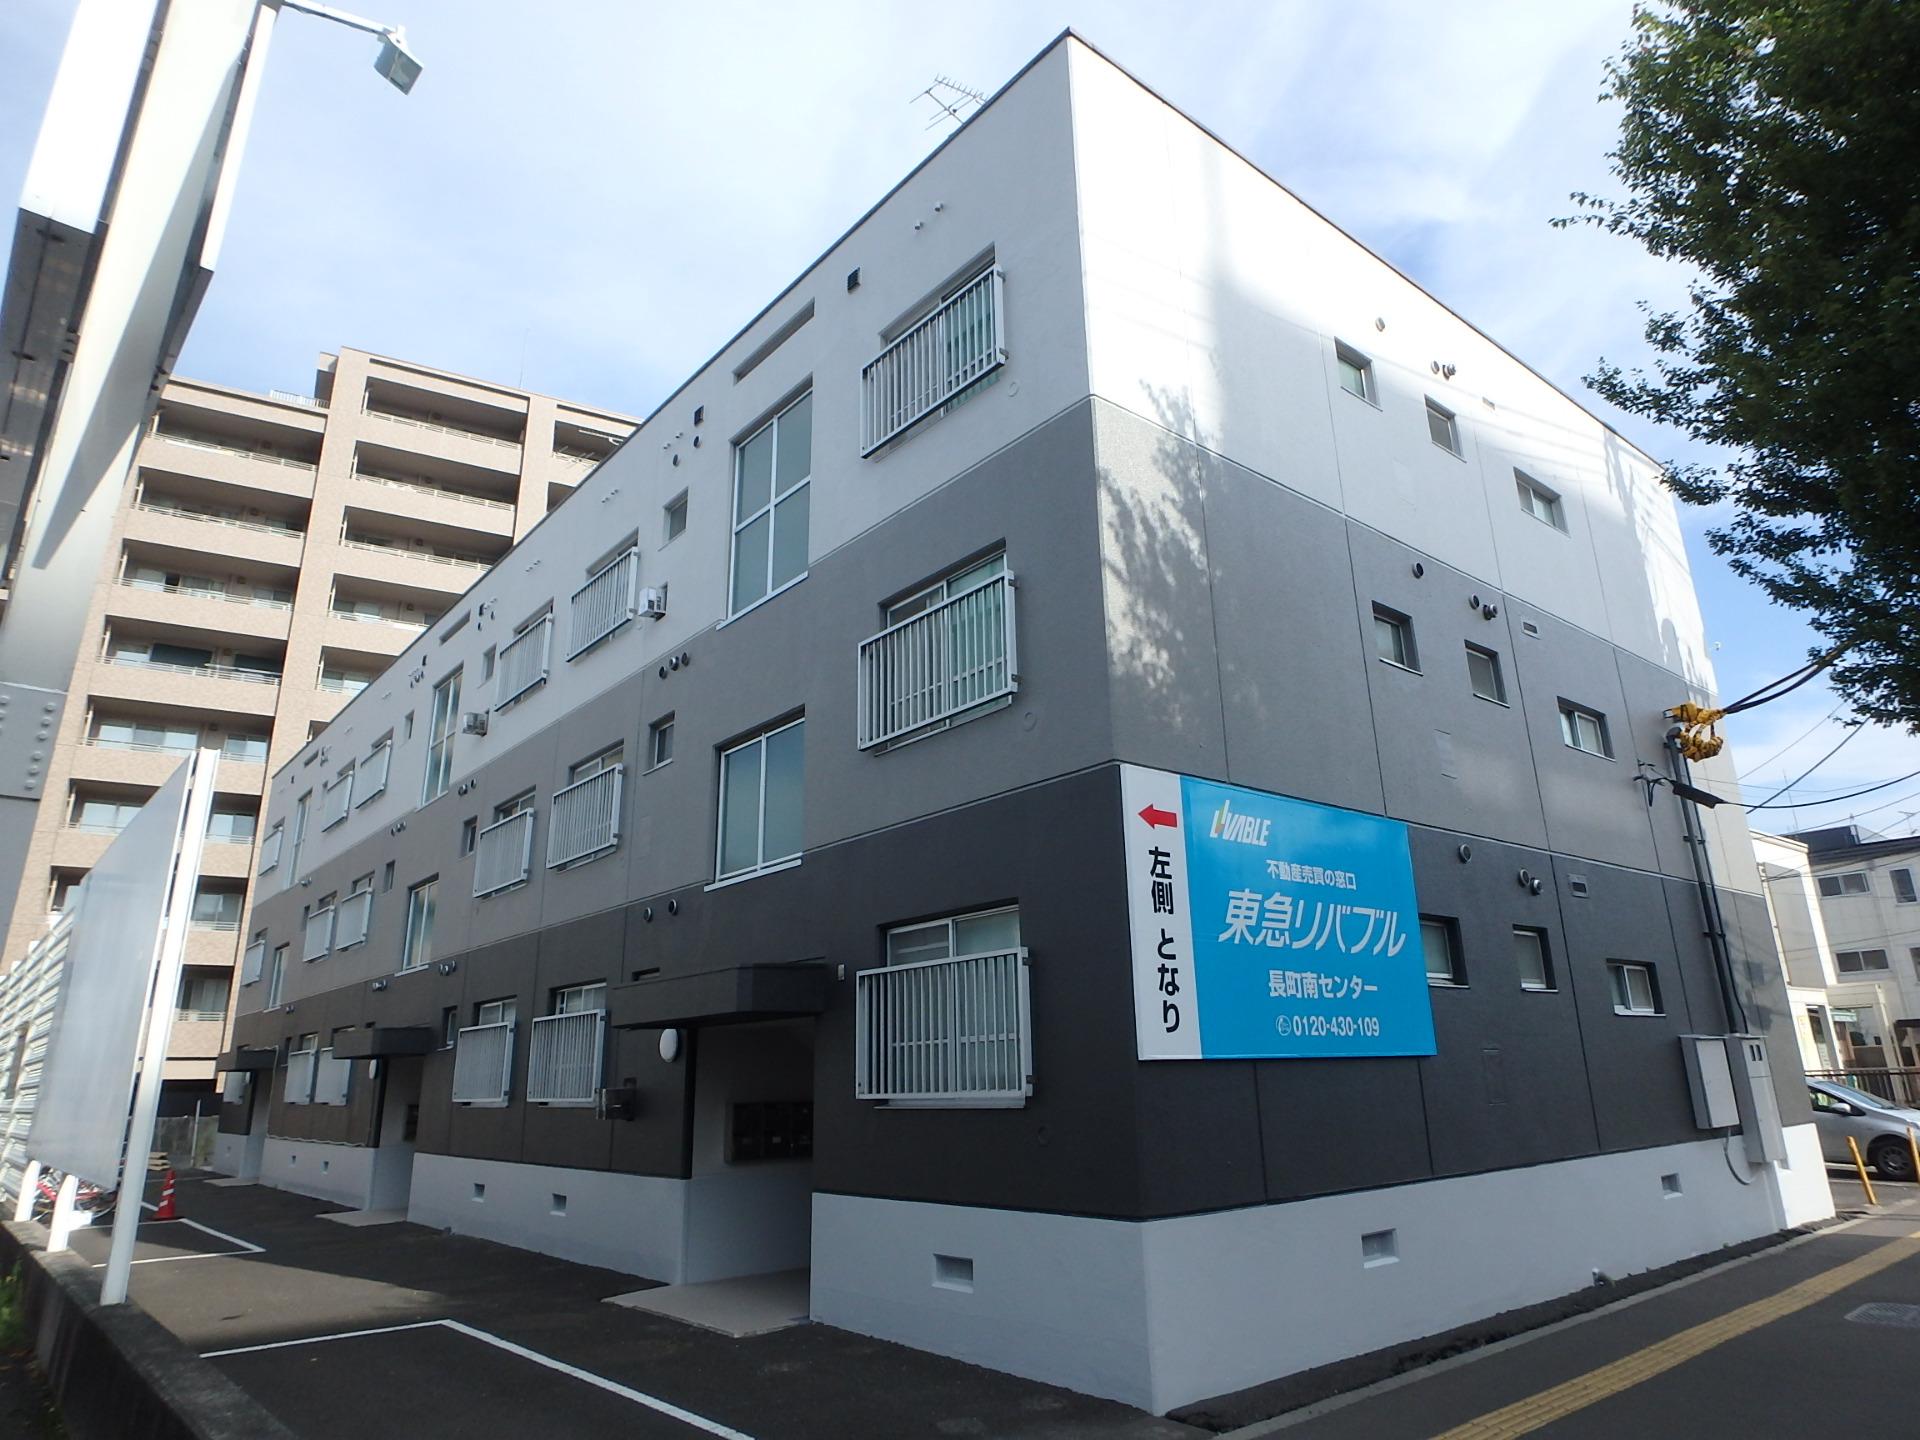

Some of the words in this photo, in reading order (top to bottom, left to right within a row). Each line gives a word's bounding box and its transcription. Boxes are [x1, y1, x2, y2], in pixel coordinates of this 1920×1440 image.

[1148, 846, 1174, 914] 左側
[1266, 859, 1357, 890] 不動産売買の窓口
[1217, 888, 1406, 957] 東急リバブル
[1157, 928, 1180, 1033] となり
[1268, 970, 1378, 999] 長町南センター
[1292, 1015, 1380, 1037] 0120-430-109
